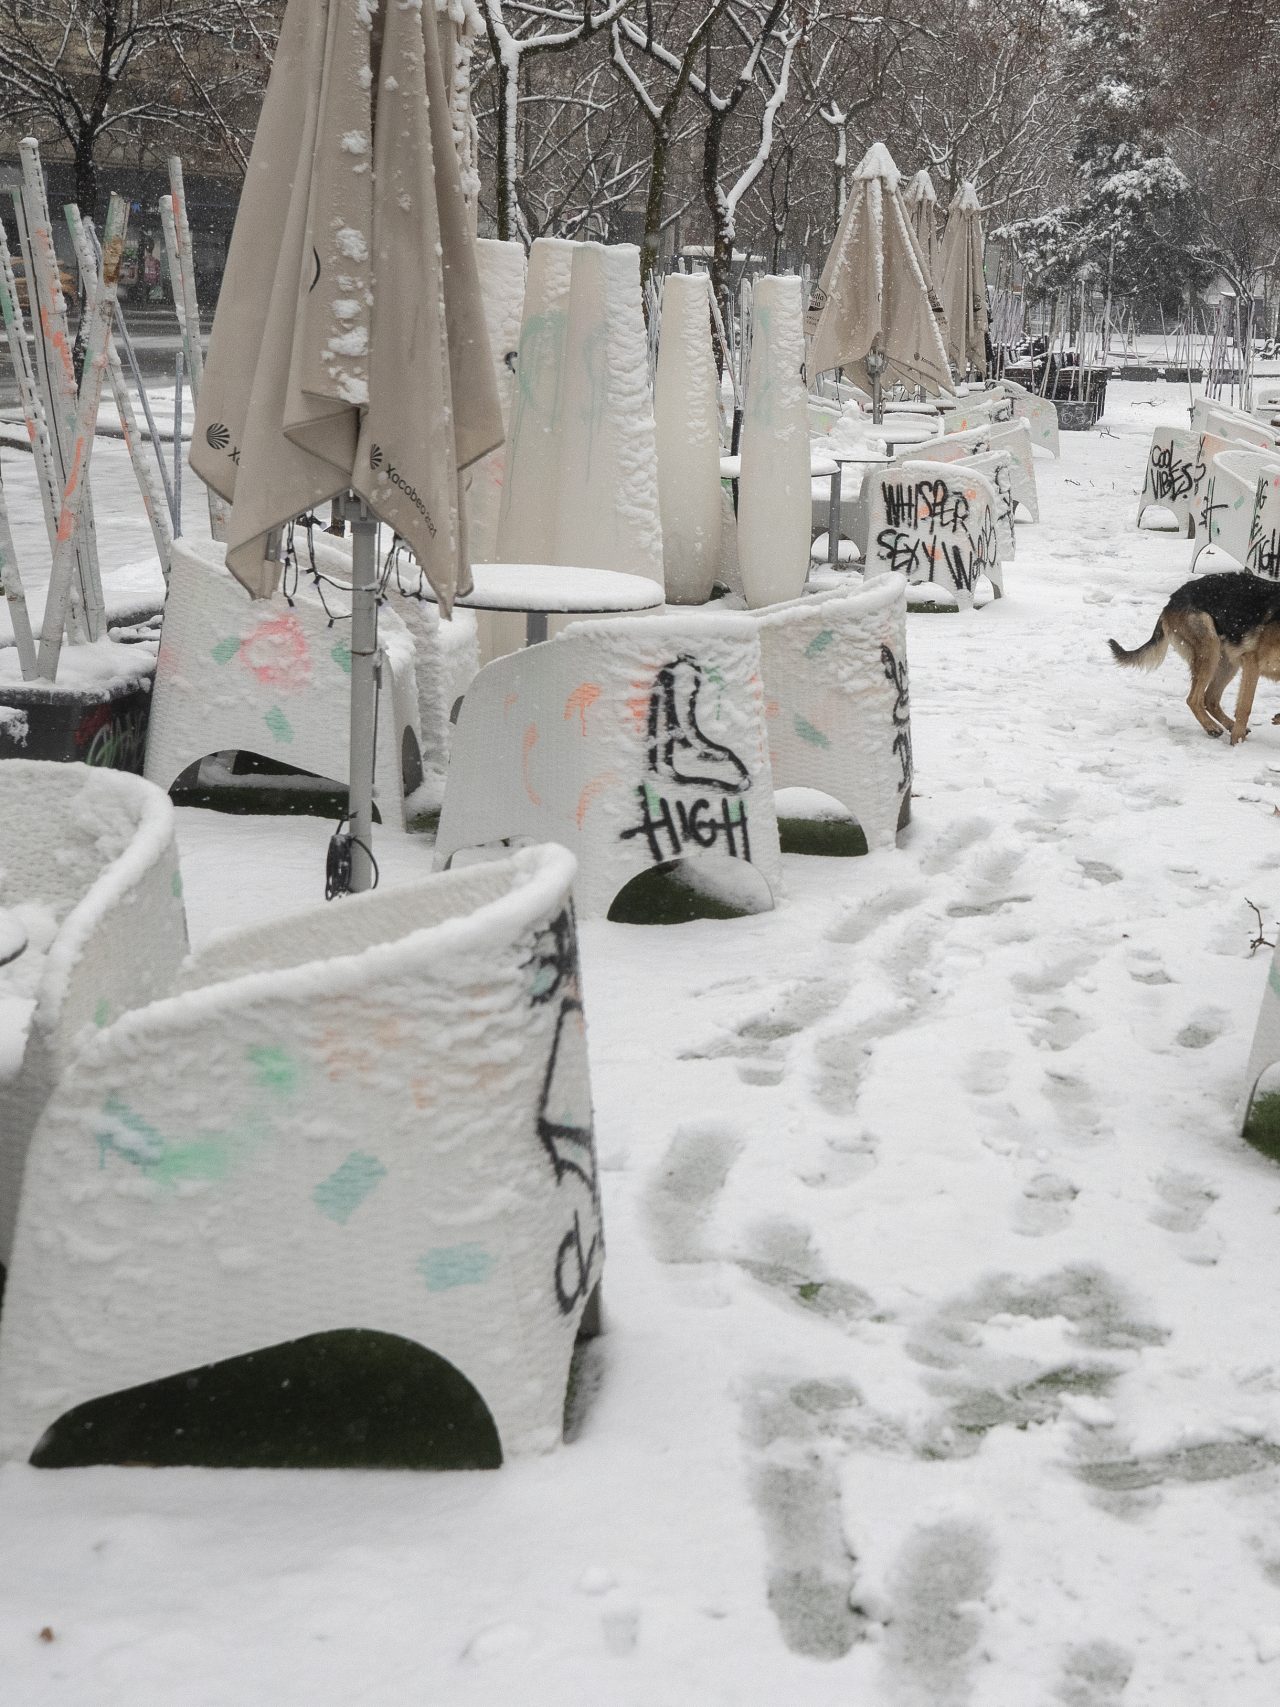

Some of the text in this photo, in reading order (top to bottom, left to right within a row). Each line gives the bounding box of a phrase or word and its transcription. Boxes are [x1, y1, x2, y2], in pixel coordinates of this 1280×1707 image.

[386, 463, 427, 516] Xacobeo
[881, 479, 976, 555] WHISPER
[876, 528, 937, 583] SEXY
[619, 784, 752, 864] HIGH
